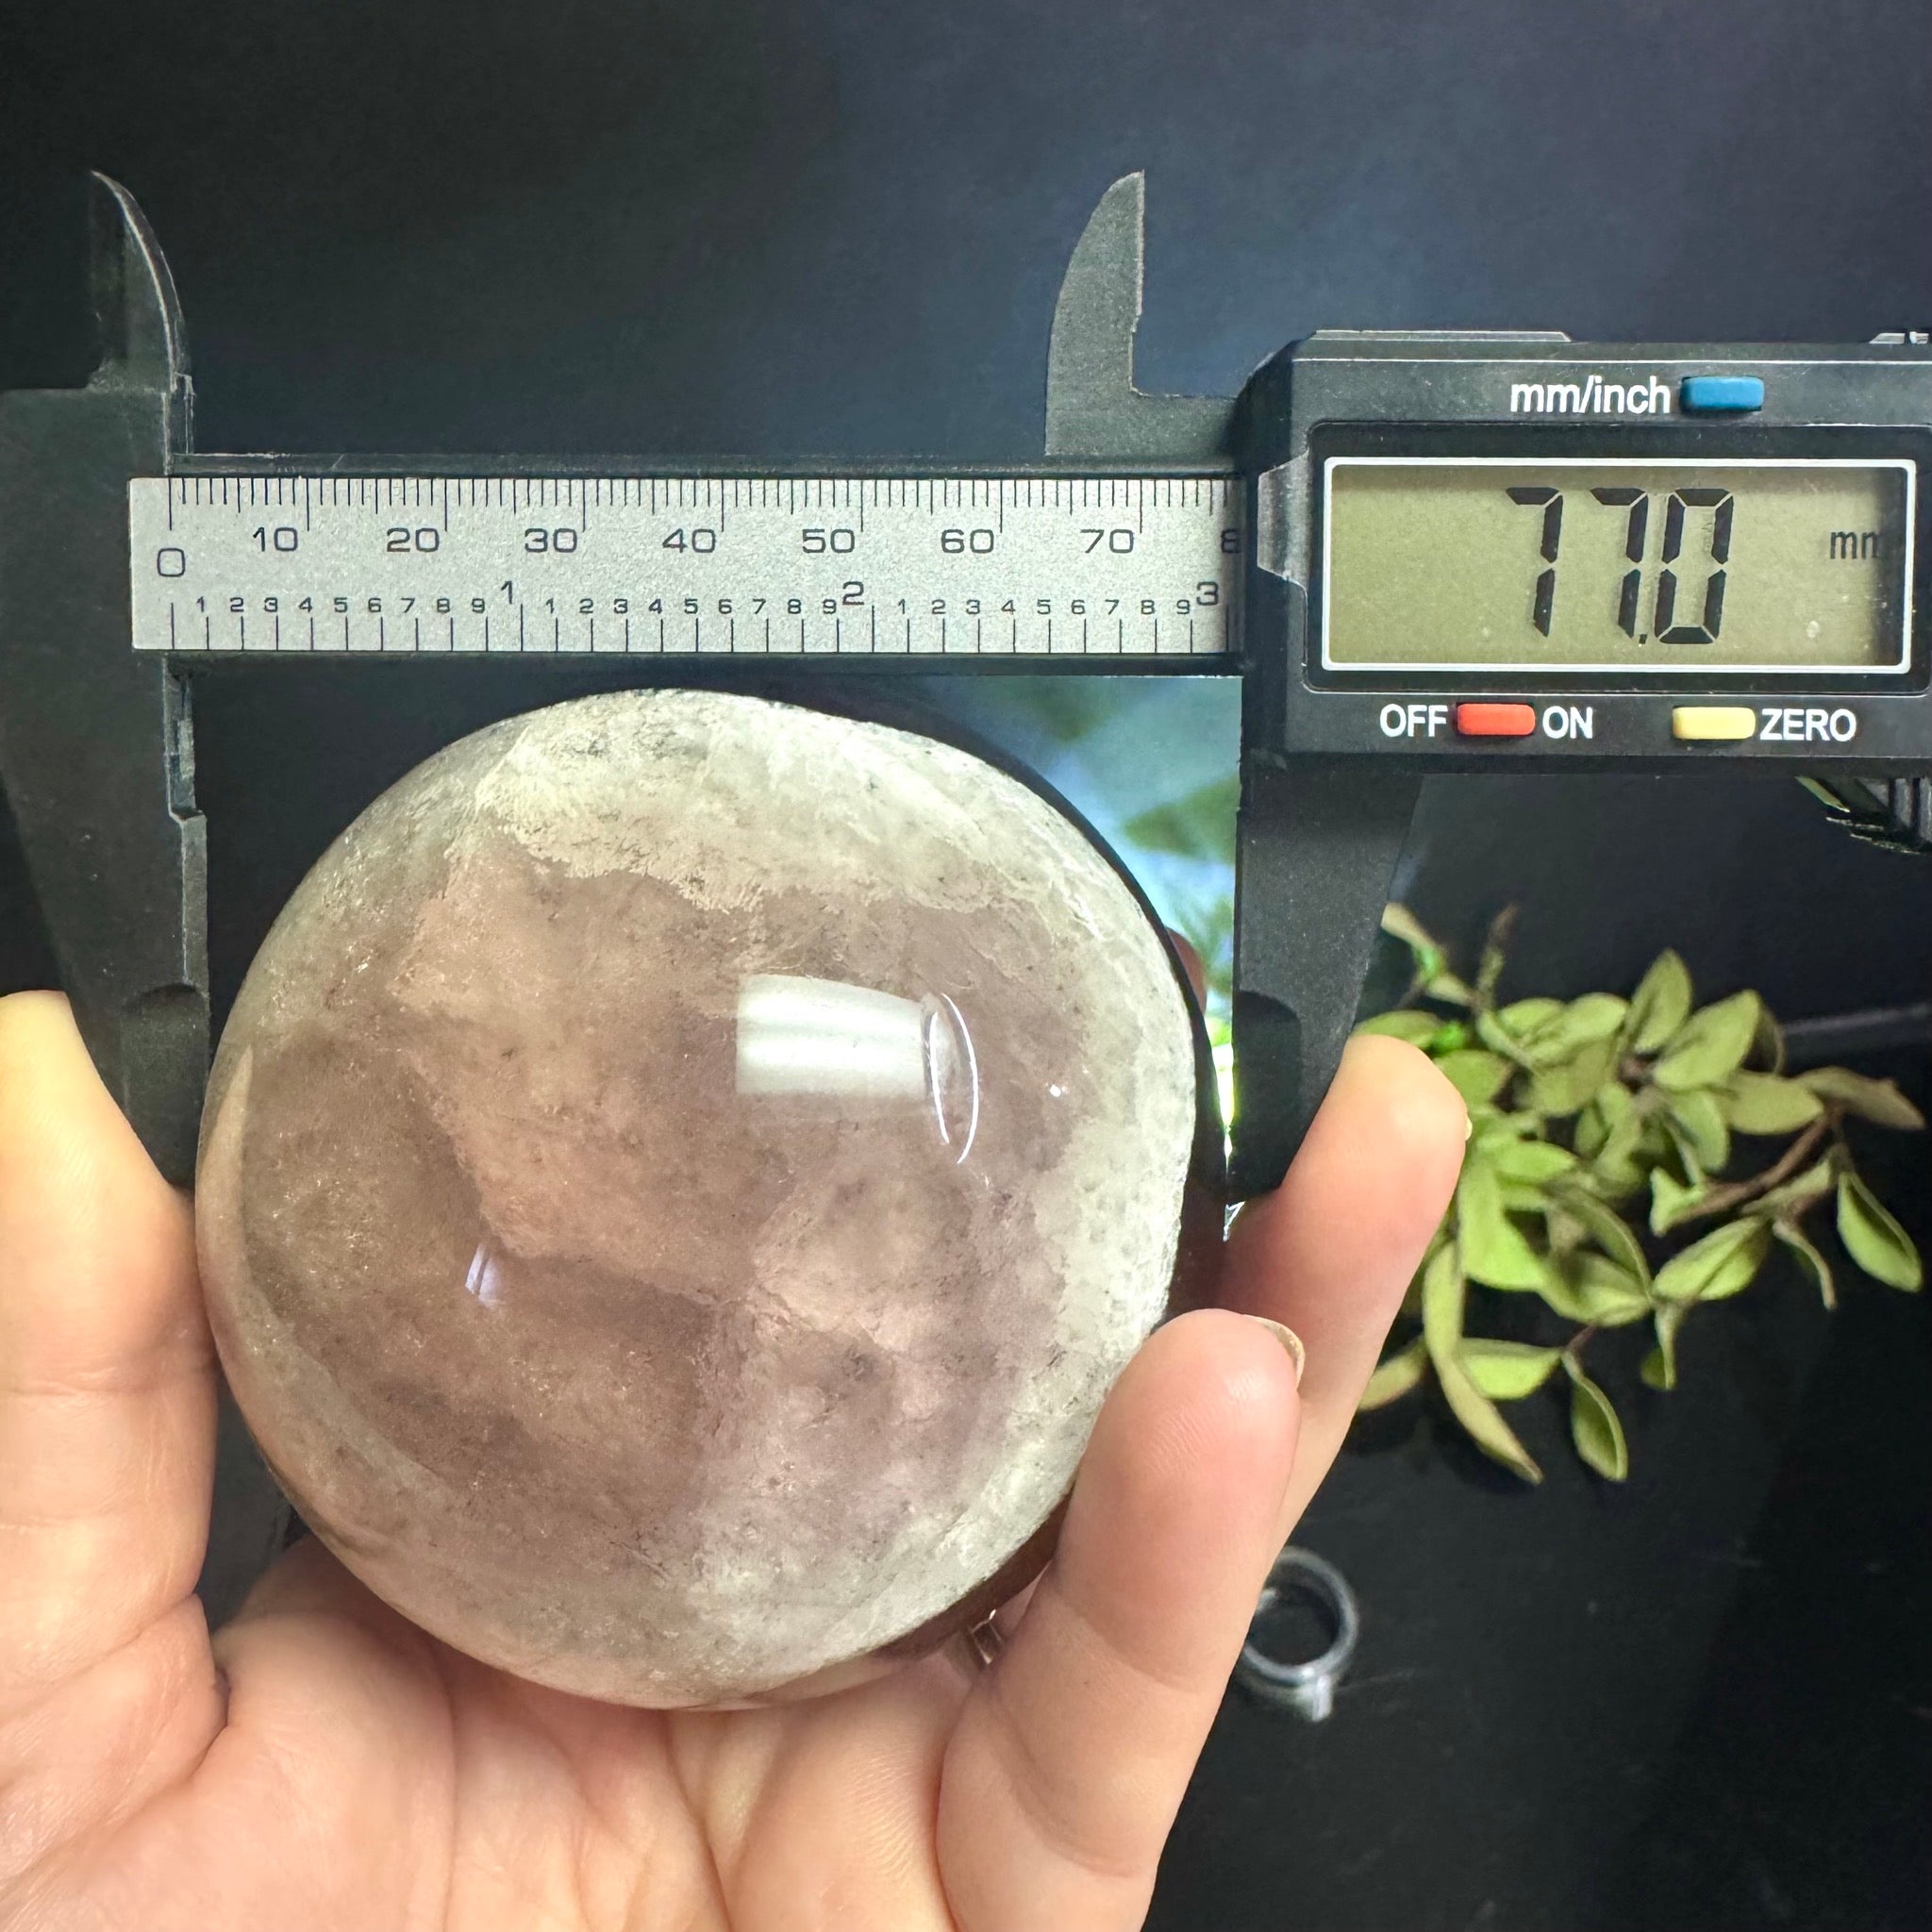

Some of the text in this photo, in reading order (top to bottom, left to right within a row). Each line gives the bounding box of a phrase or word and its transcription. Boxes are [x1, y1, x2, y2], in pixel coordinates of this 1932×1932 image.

[1510, 375, 1671, 413] mm/inch
[156, 547, 186, 577] 0
[252, 525, 299, 553] 10
[386, 527, 440, 553] 20
[524, 527, 578, 554] 30
[662, 527, 717, 554] 40
[802, 527, 856, 554] 50
[941, 527, 995, 554] 60
[1079, 527, 1135, 554] 70
[1506, 486, 1734, 644] 77.0
[195, 579, 1220, 615] 1 2 3 4 5 6 7 8 9 1 1 2 3 4 5 6 7 8 9 2 1 2 3 4 5 6 7 8 9 3
[1379, 704, 1593, 740] OFF ON
[1759, 708, 1857, 742] ZERO
